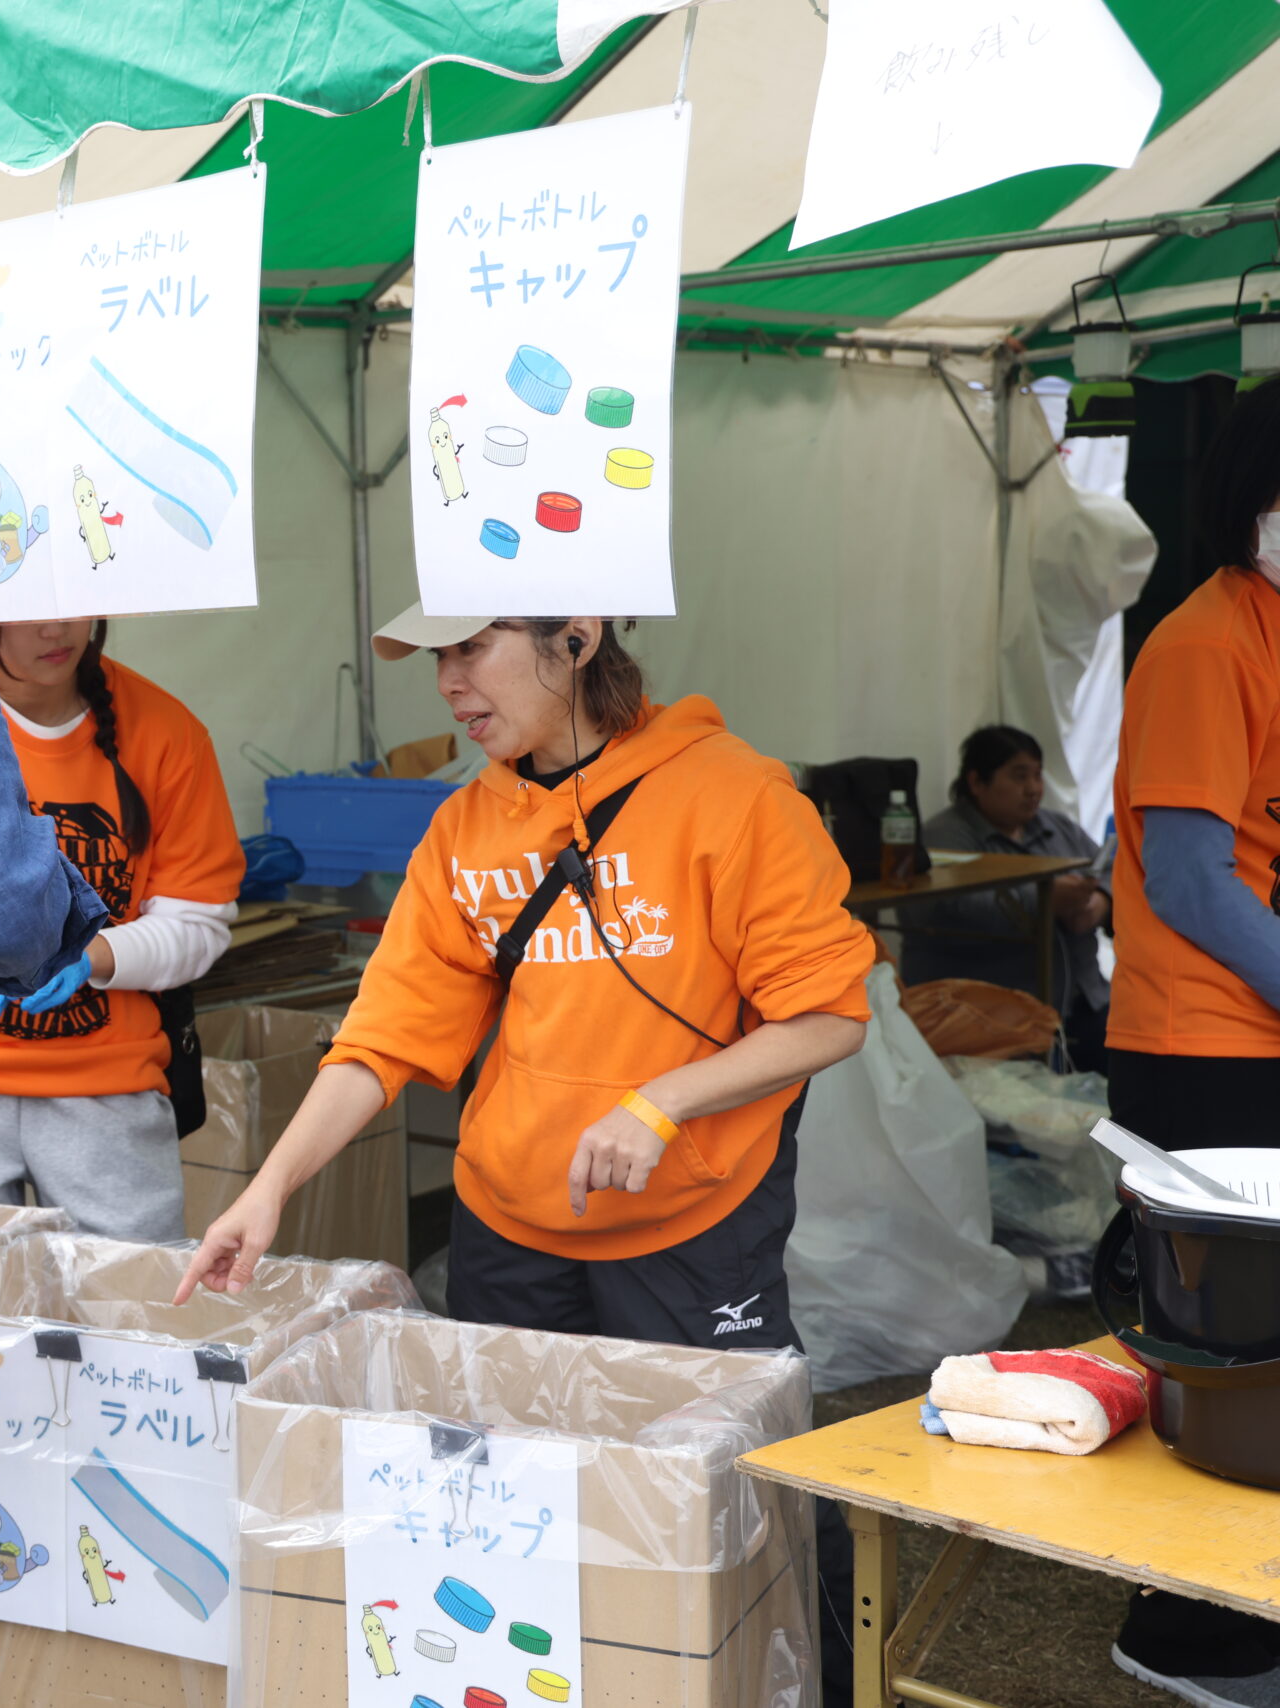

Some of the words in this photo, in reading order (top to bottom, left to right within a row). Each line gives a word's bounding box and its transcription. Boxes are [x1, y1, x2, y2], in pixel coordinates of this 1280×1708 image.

[448, 189, 607, 240] ペットボトル
[80, 230, 190, 269] ペットボトル
[469, 213, 648, 308] キャップ
[100, 274, 210, 333] ラベル
[713, 1316, 763, 1336] MIZUNO
[79, 1362, 183, 1396] ペットボトル
[100, 1400, 205, 1447] ラベル
[369, 1463, 516, 1504] ペットボトル
[394, 1502, 553, 1559] キャップ
